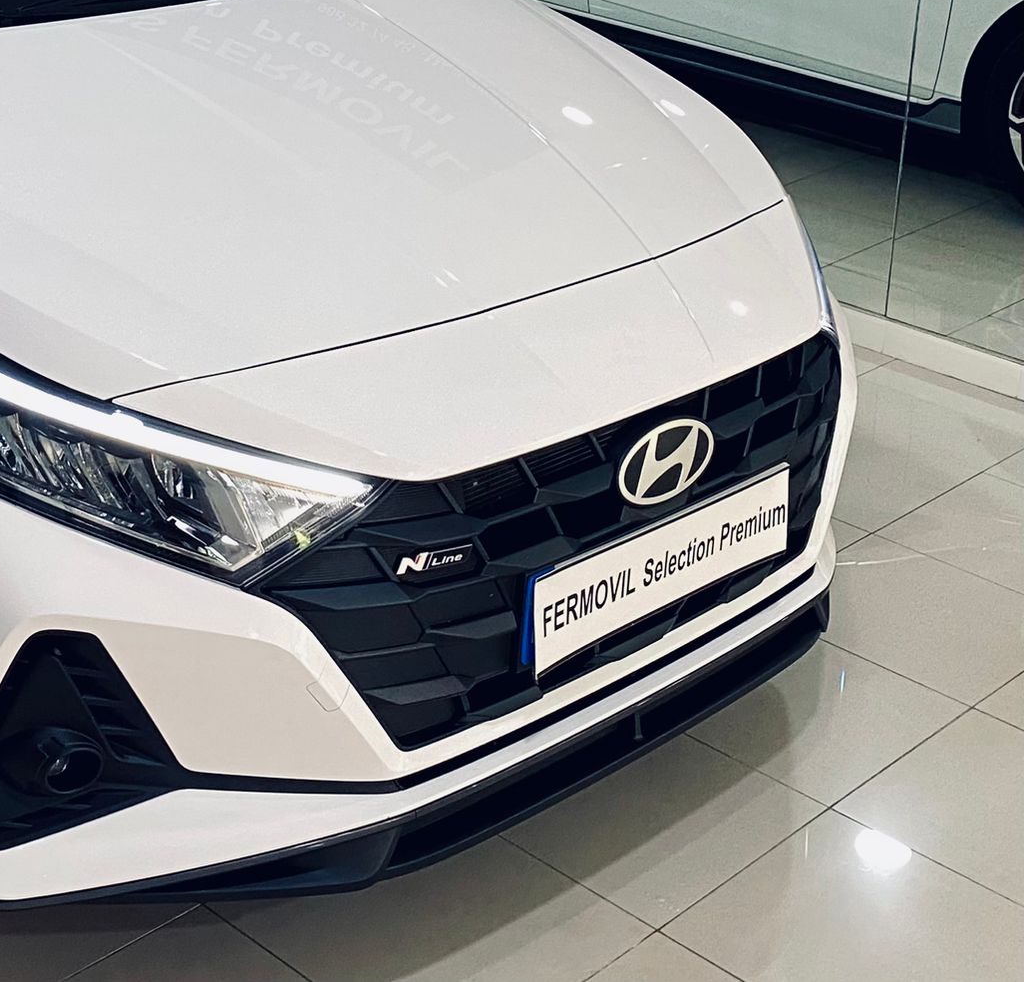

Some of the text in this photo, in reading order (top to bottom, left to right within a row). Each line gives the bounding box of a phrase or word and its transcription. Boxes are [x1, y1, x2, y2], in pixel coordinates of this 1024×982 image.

[431, 553, 463, 566] Line
[542, 503, 786, 638] FERMOVIL Selection Premium
